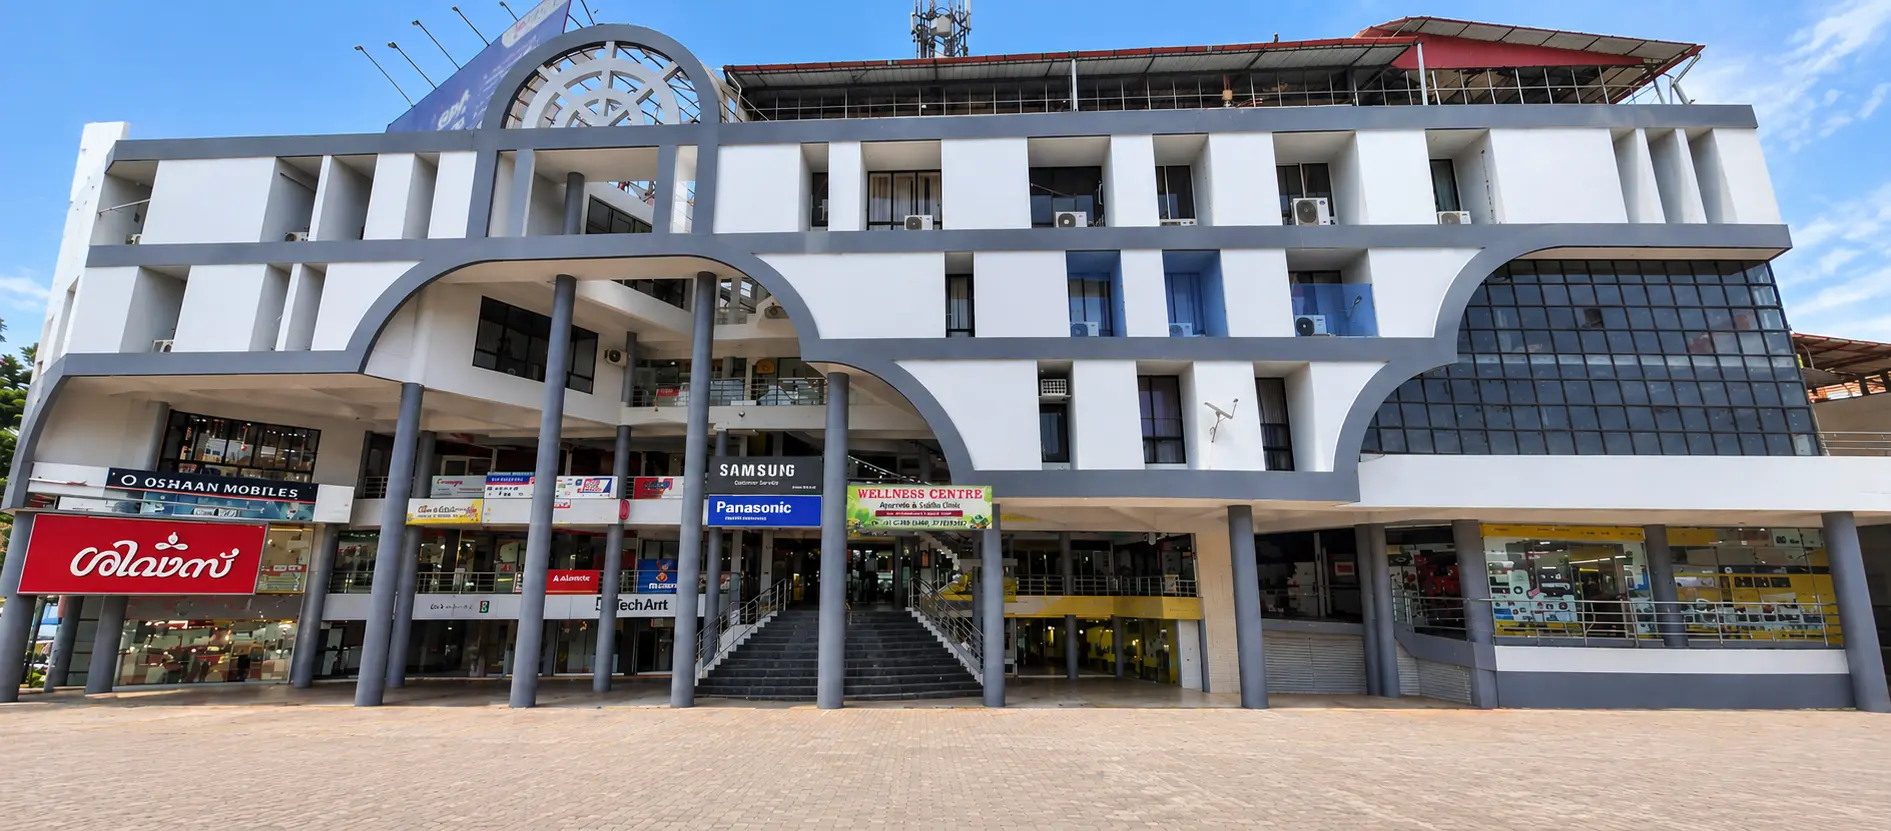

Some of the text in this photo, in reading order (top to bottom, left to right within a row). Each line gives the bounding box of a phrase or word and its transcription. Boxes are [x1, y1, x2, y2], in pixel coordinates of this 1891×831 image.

[719, 463, 795, 477] SAMSUNG
[144, 477, 219, 493] OSHAAN
[223, 484, 299, 498] MOBILES
[857, 488, 983, 499] WELLNESS CENTRE
[716, 501, 792, 514] Panasonic
